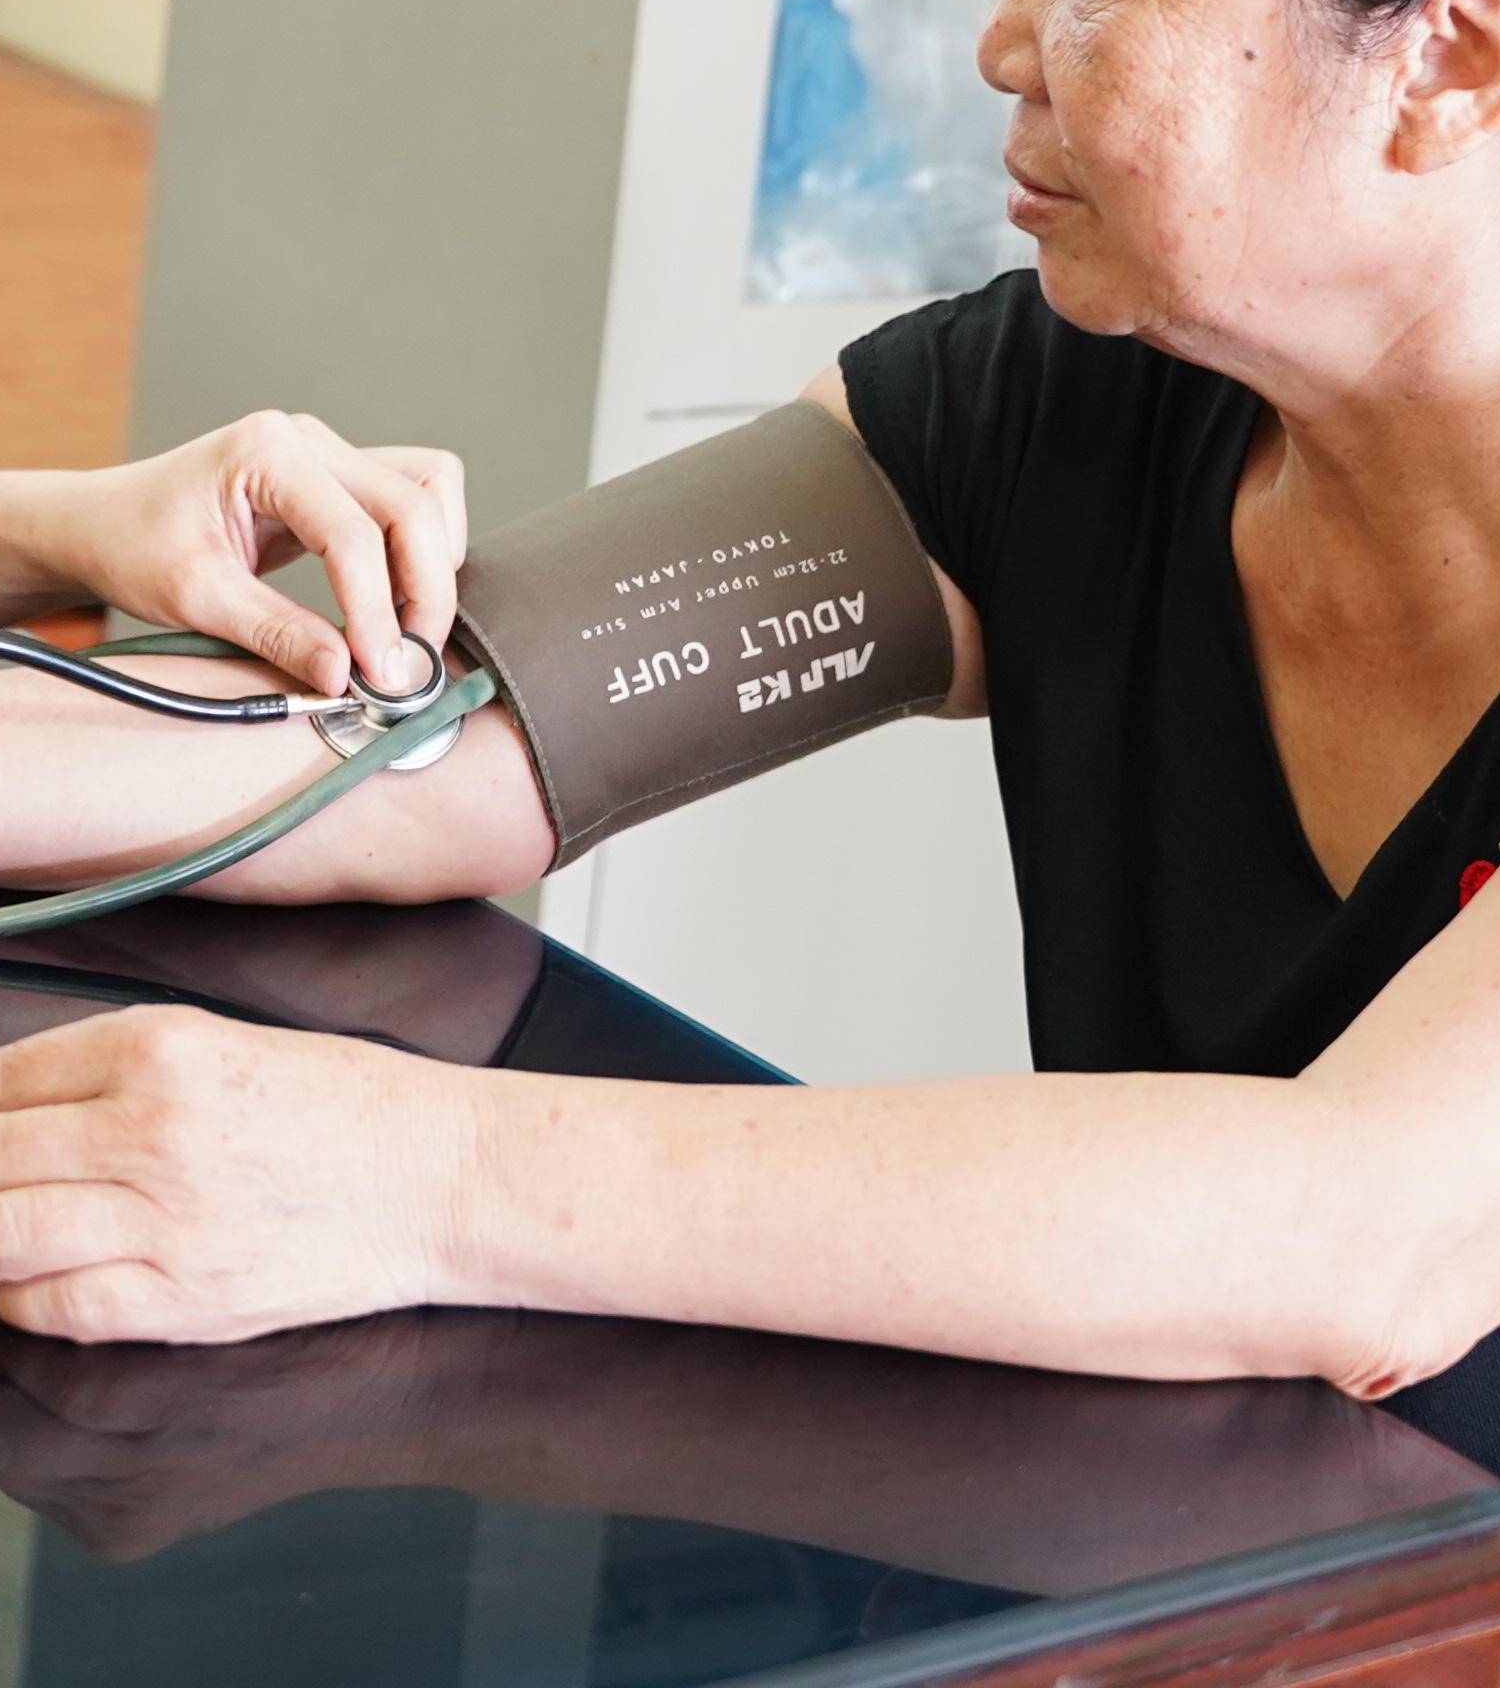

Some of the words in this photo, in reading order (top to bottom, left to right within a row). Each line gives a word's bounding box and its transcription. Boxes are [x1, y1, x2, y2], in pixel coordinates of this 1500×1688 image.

[696, 575, 760, 603] Upper
[639, 597, 680, 619] Arm
[581, 617, 627, 640] Size
[740, 590, 865, 660] ADULT
[607, 641, 710, 704] CUFF
